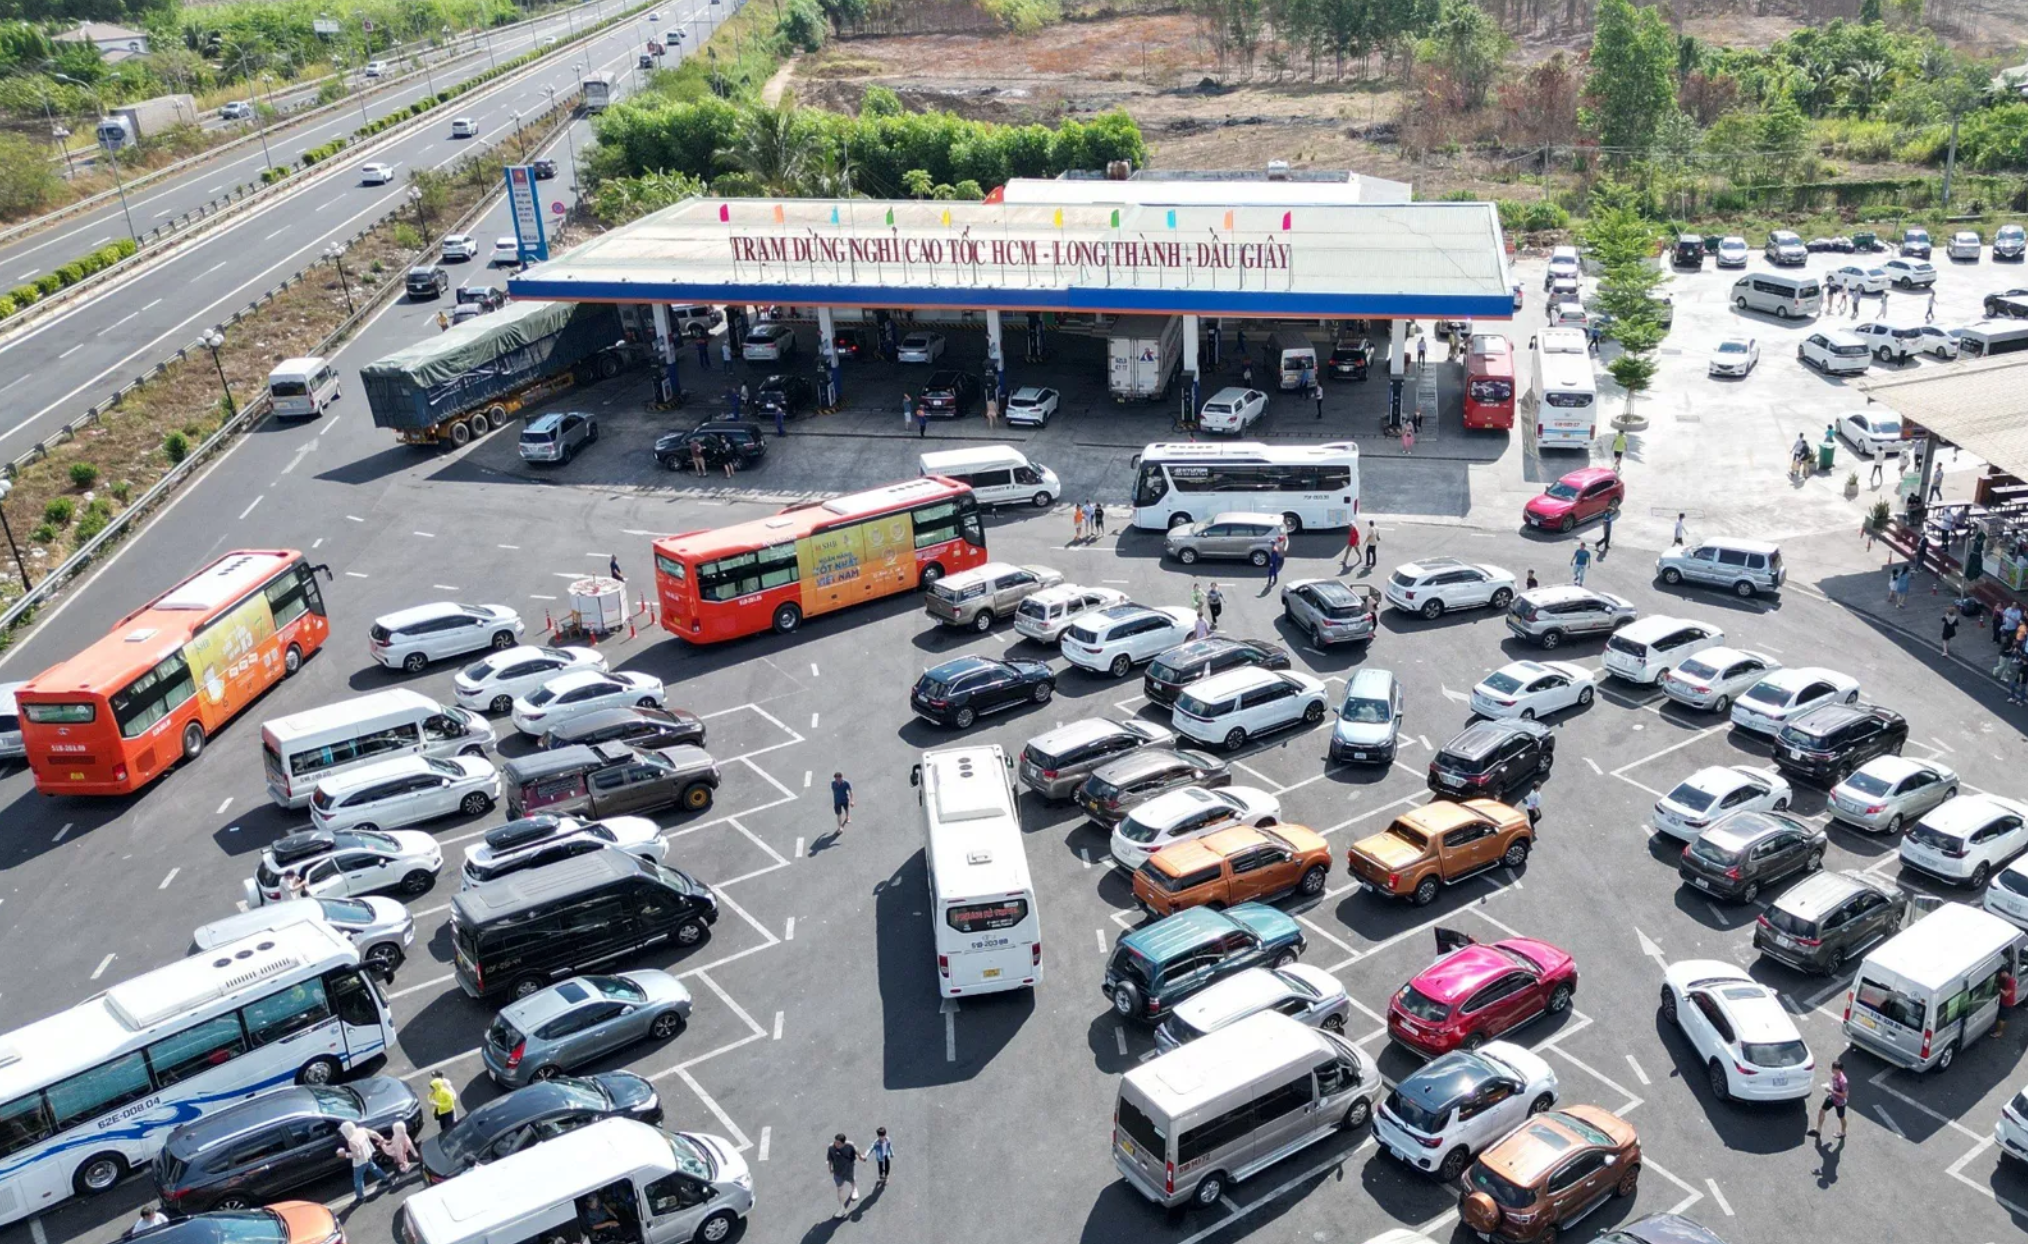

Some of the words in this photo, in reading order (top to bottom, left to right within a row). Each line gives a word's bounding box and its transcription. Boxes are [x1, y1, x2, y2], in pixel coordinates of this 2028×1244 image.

[792, 227, 846, 263] DỪNG
[850, 226, 900, 263] NGHỈ
[904, 238, 943, 264] CAO
[947, 225, 986, 264] TỐC
[992, 239, 1038, 265] HCM
[1054, 240, 1106, 267] LONG
[1111, 232, 1181, 267] THÀNH
[1197, 226, 1235, 268] DẦU
[1240, 234, 1291, 269] GIÂY
